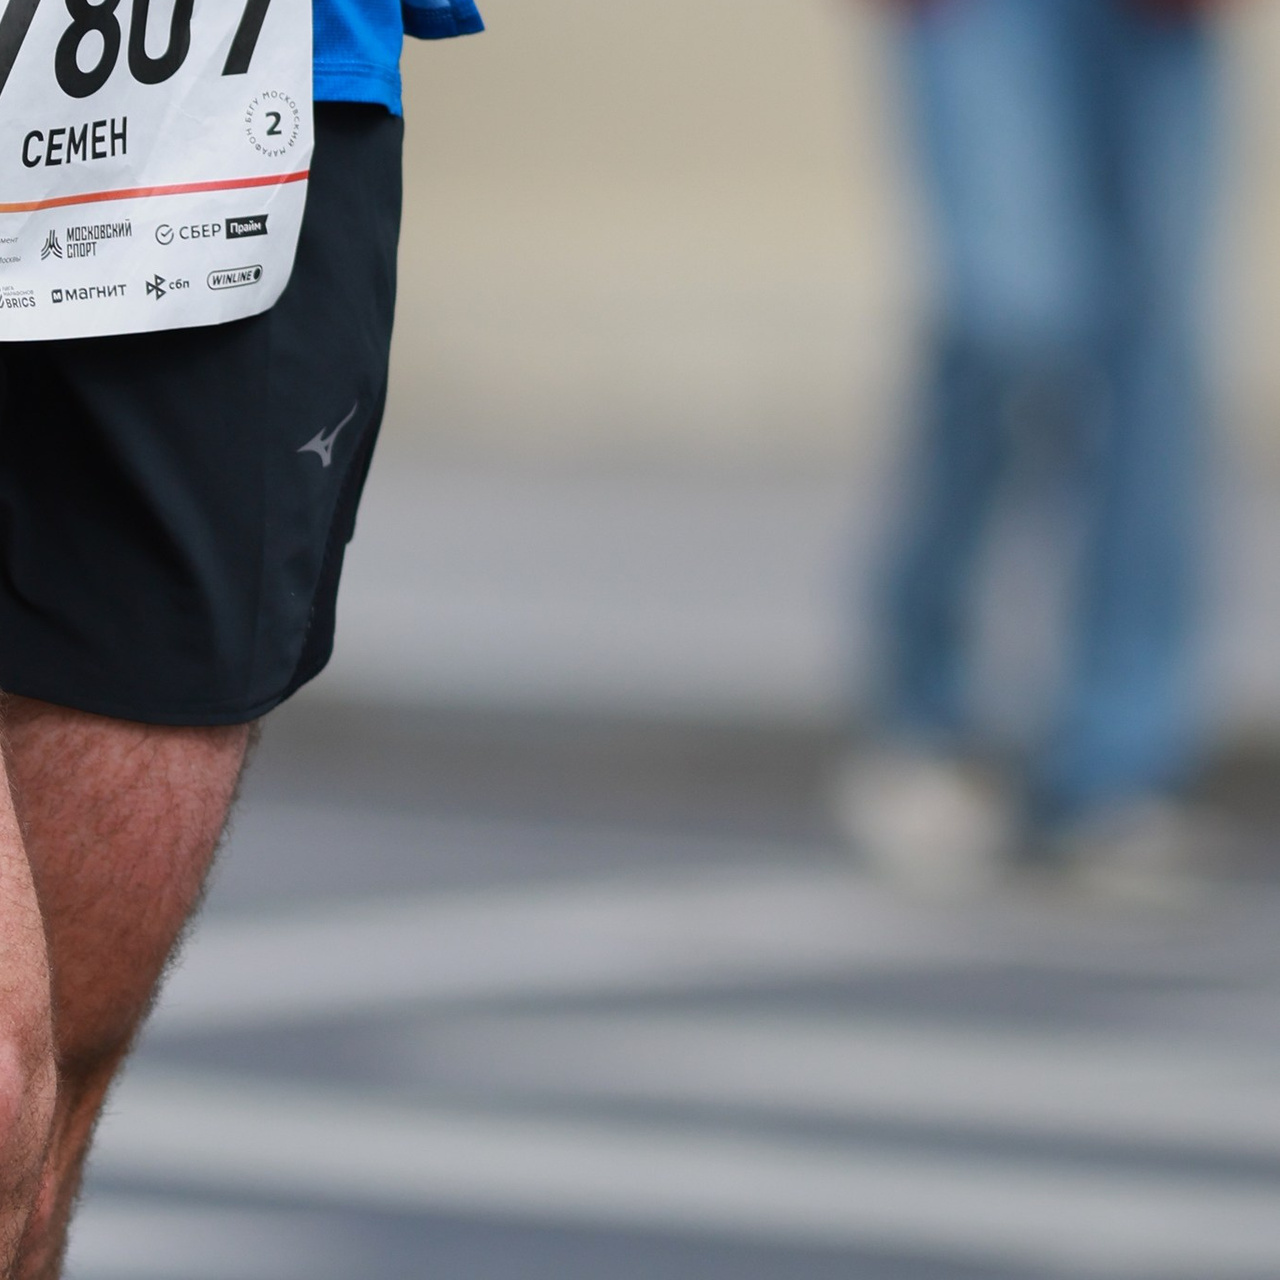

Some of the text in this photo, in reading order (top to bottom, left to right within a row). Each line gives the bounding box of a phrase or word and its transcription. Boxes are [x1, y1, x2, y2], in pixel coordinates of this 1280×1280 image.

[244, 97, 259, 124] БЕГУ
[265, 110, 282, 136] 2
[22, 116, 128, 168] СЕМЕН
[245, 127, 286, 158] МАРАФОН
[66, 218, 133, 243] МОСКОВСКИЙ
[179, 220, 262, 240] СБЕР Прайм
[66, 241, 98, 259] СПОРТ
[168, 278, 190, 290] сбп
[212, 270, 253, 286] WINLINE
[5, 296, 37, 309] BRICS
[65, 284, 127, 302] магнит
